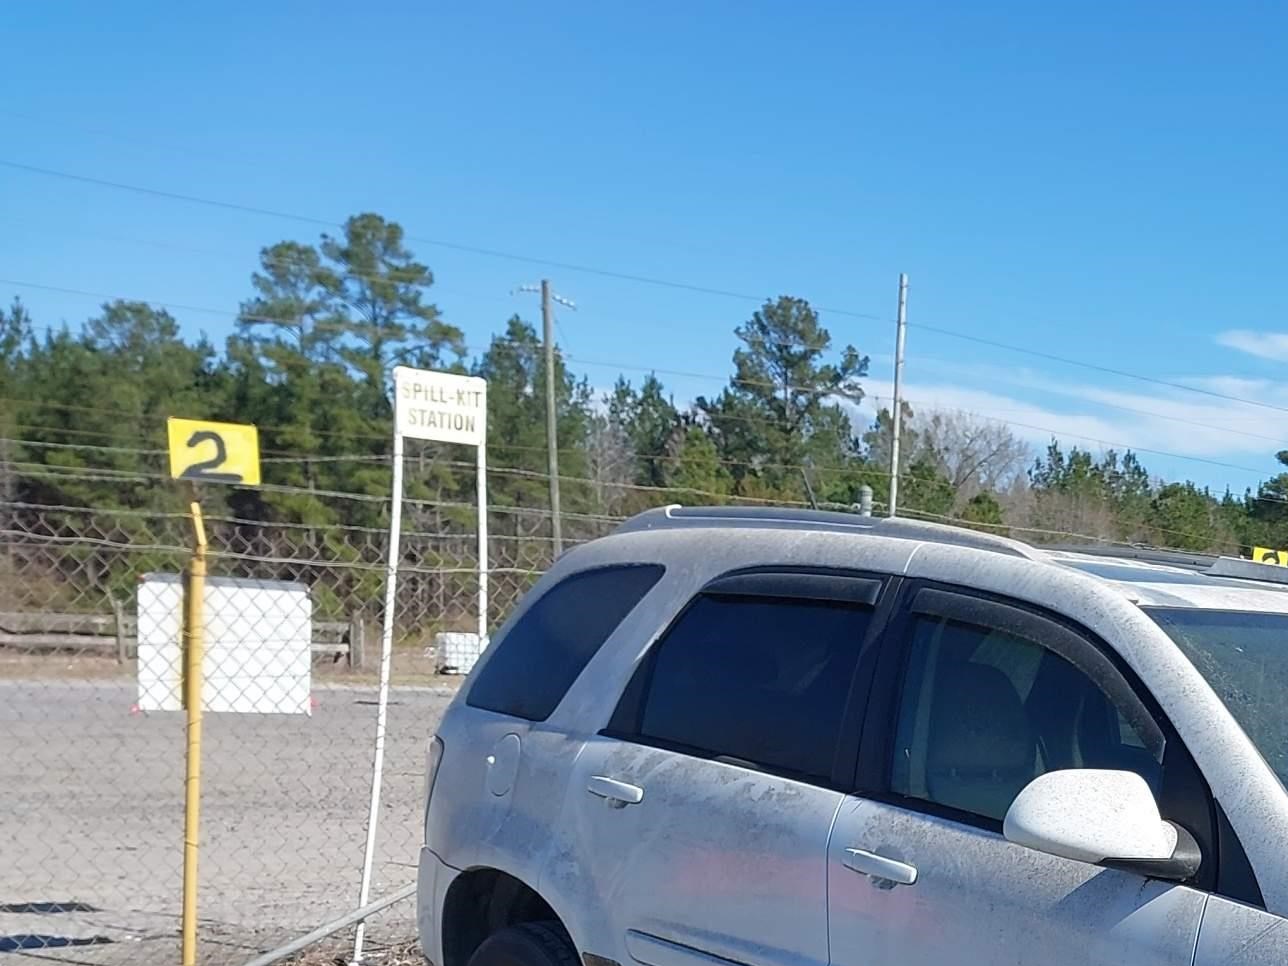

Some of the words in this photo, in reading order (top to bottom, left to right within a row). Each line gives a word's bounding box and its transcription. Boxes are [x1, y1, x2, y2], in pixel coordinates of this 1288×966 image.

[402, 381, 482, 408] SPILL-KIT
[408, 407, 475, 432] STATION
[180, 431, 244, 482] 2
